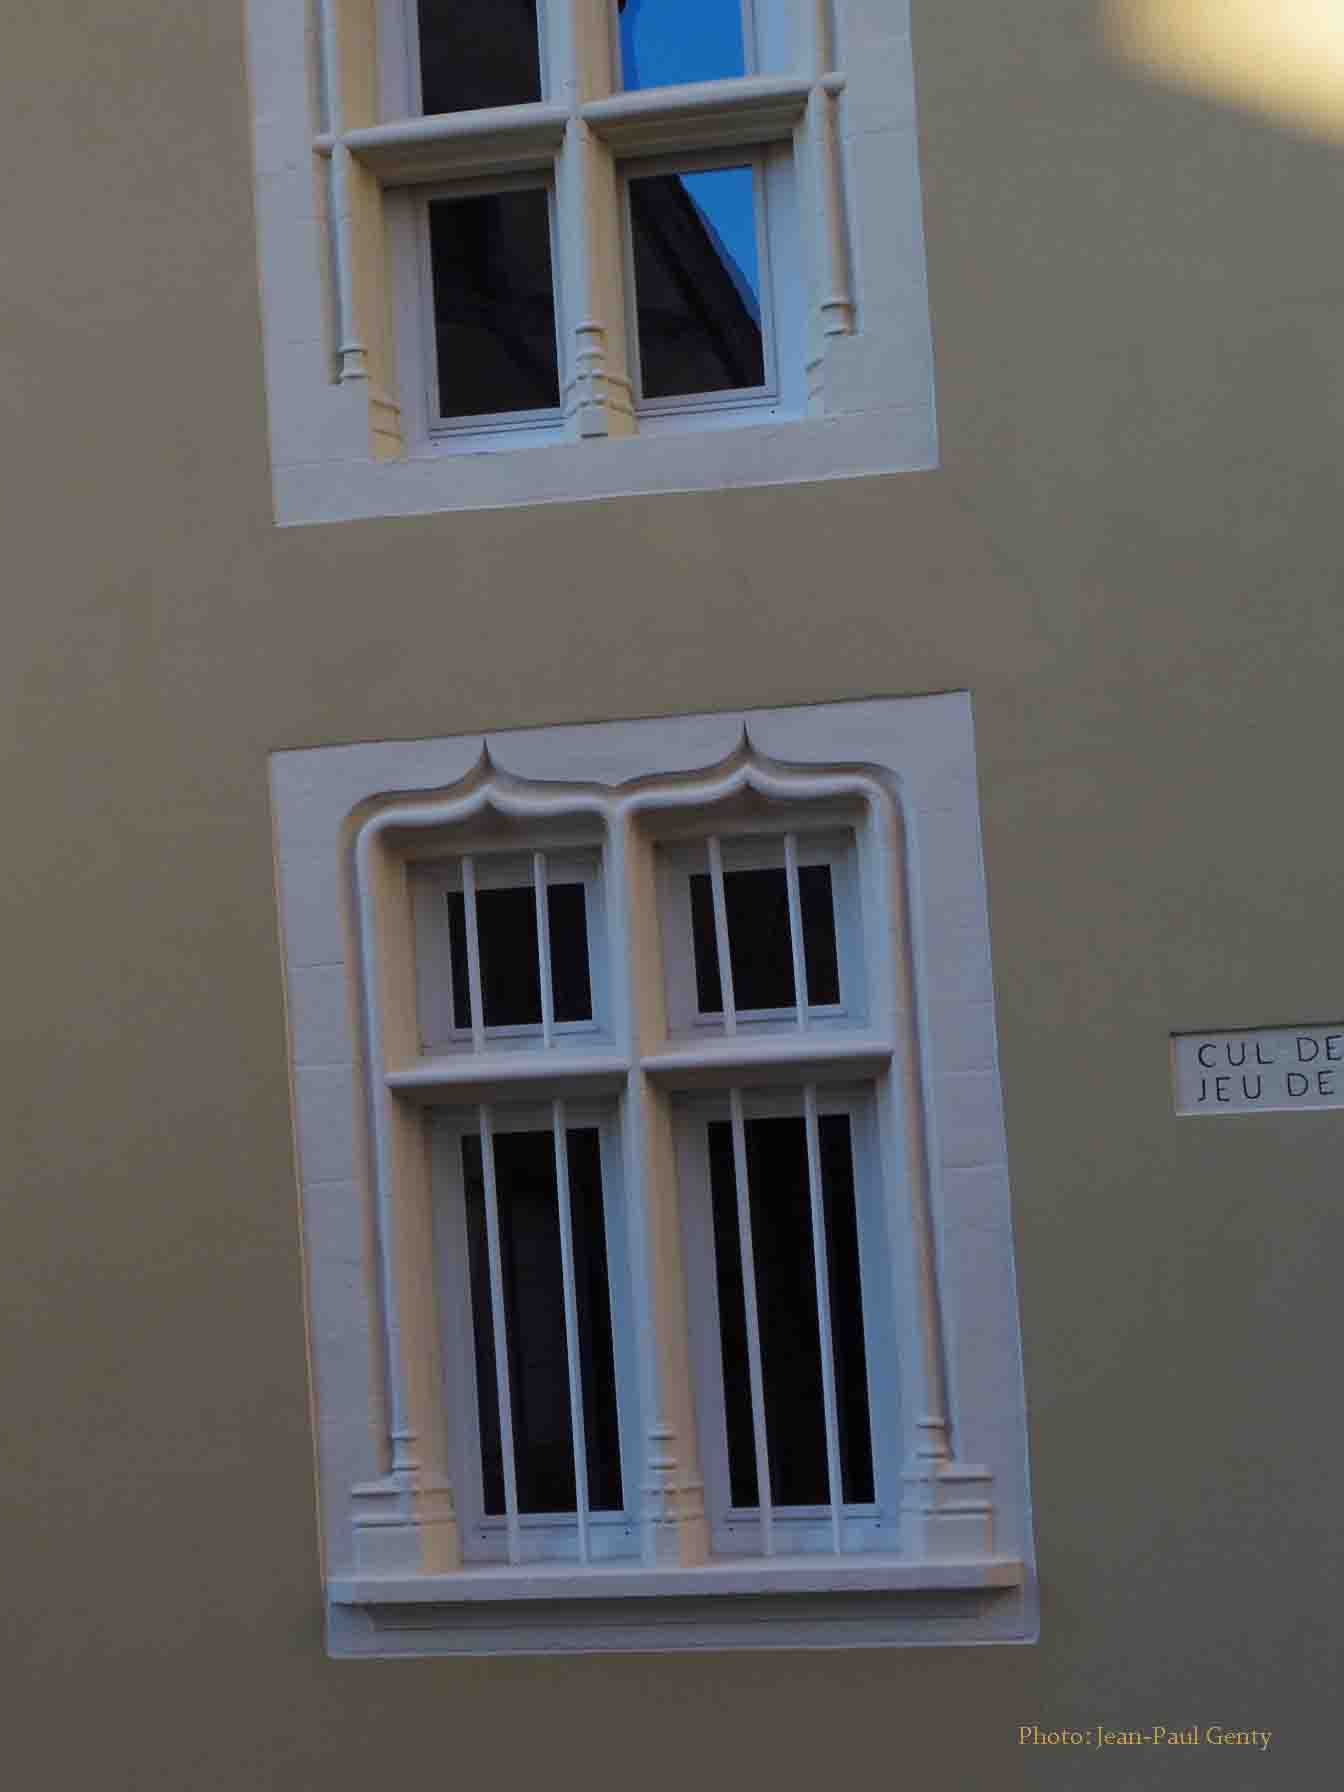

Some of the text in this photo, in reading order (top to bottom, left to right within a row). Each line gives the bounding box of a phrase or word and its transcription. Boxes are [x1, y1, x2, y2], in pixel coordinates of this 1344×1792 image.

[1197, 1034, 1344, 1068] CUL DE
[1197, 1070, 1335, 1102] JEU DE
